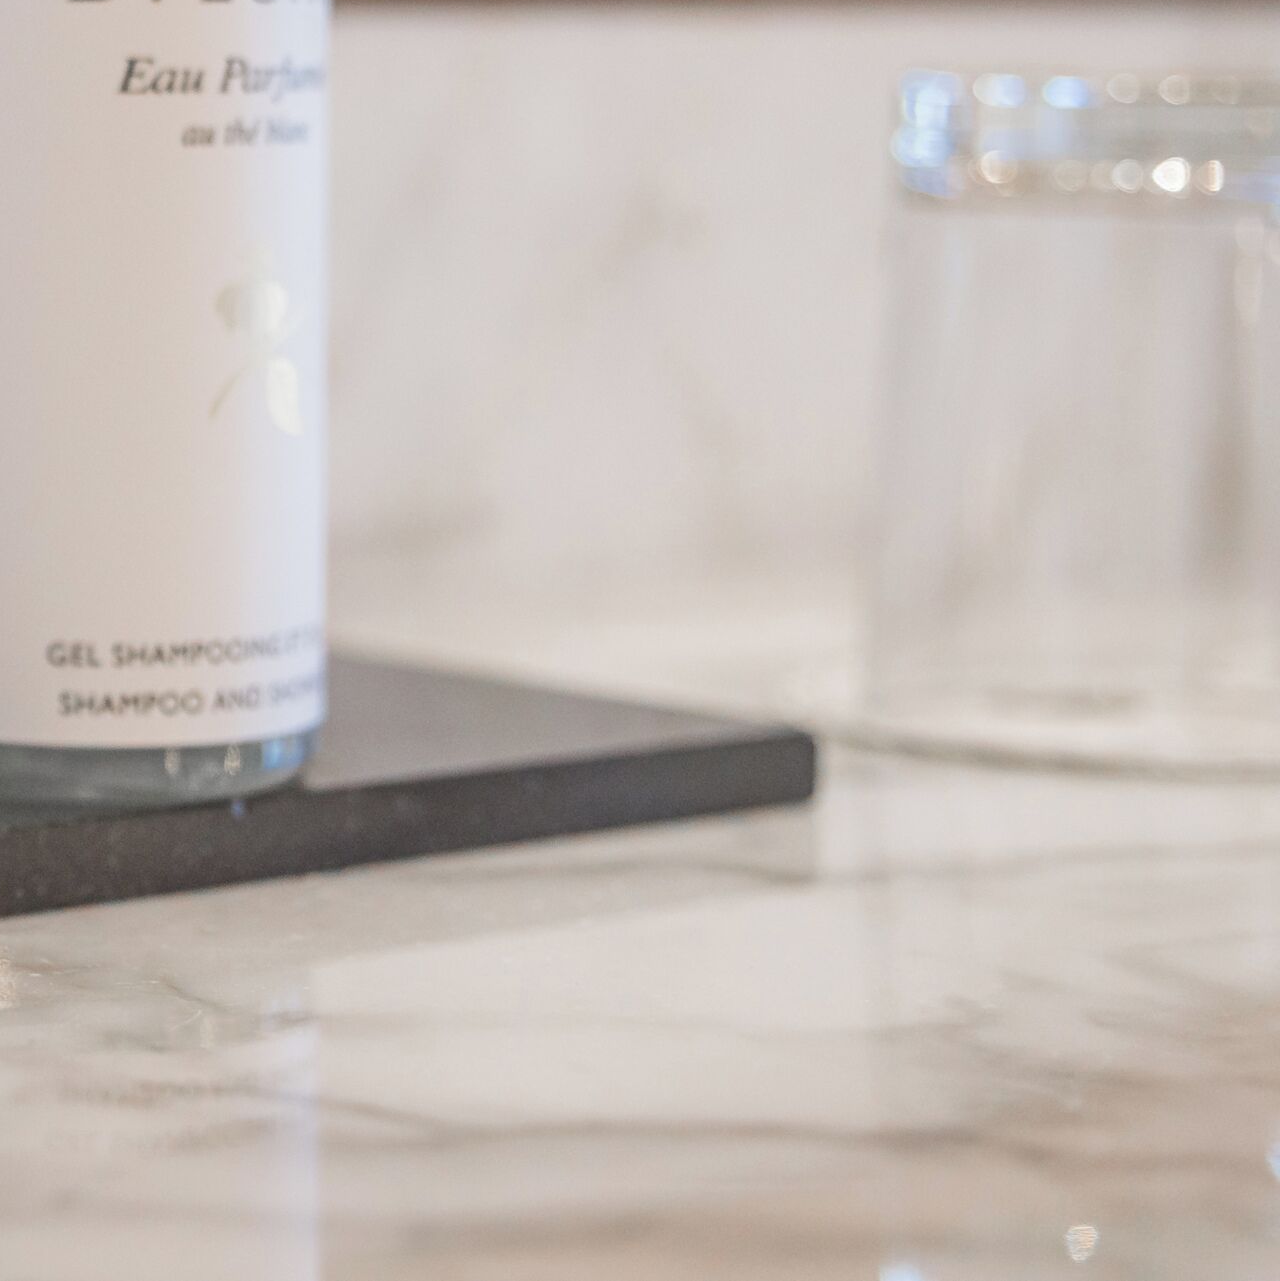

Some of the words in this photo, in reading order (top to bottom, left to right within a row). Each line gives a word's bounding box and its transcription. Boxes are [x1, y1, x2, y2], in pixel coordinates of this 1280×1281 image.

[118, 55, 204, 96] Eau
[45, 641, 100, 668] GEL
[57, 688, 204, 716] SHAMPOO
